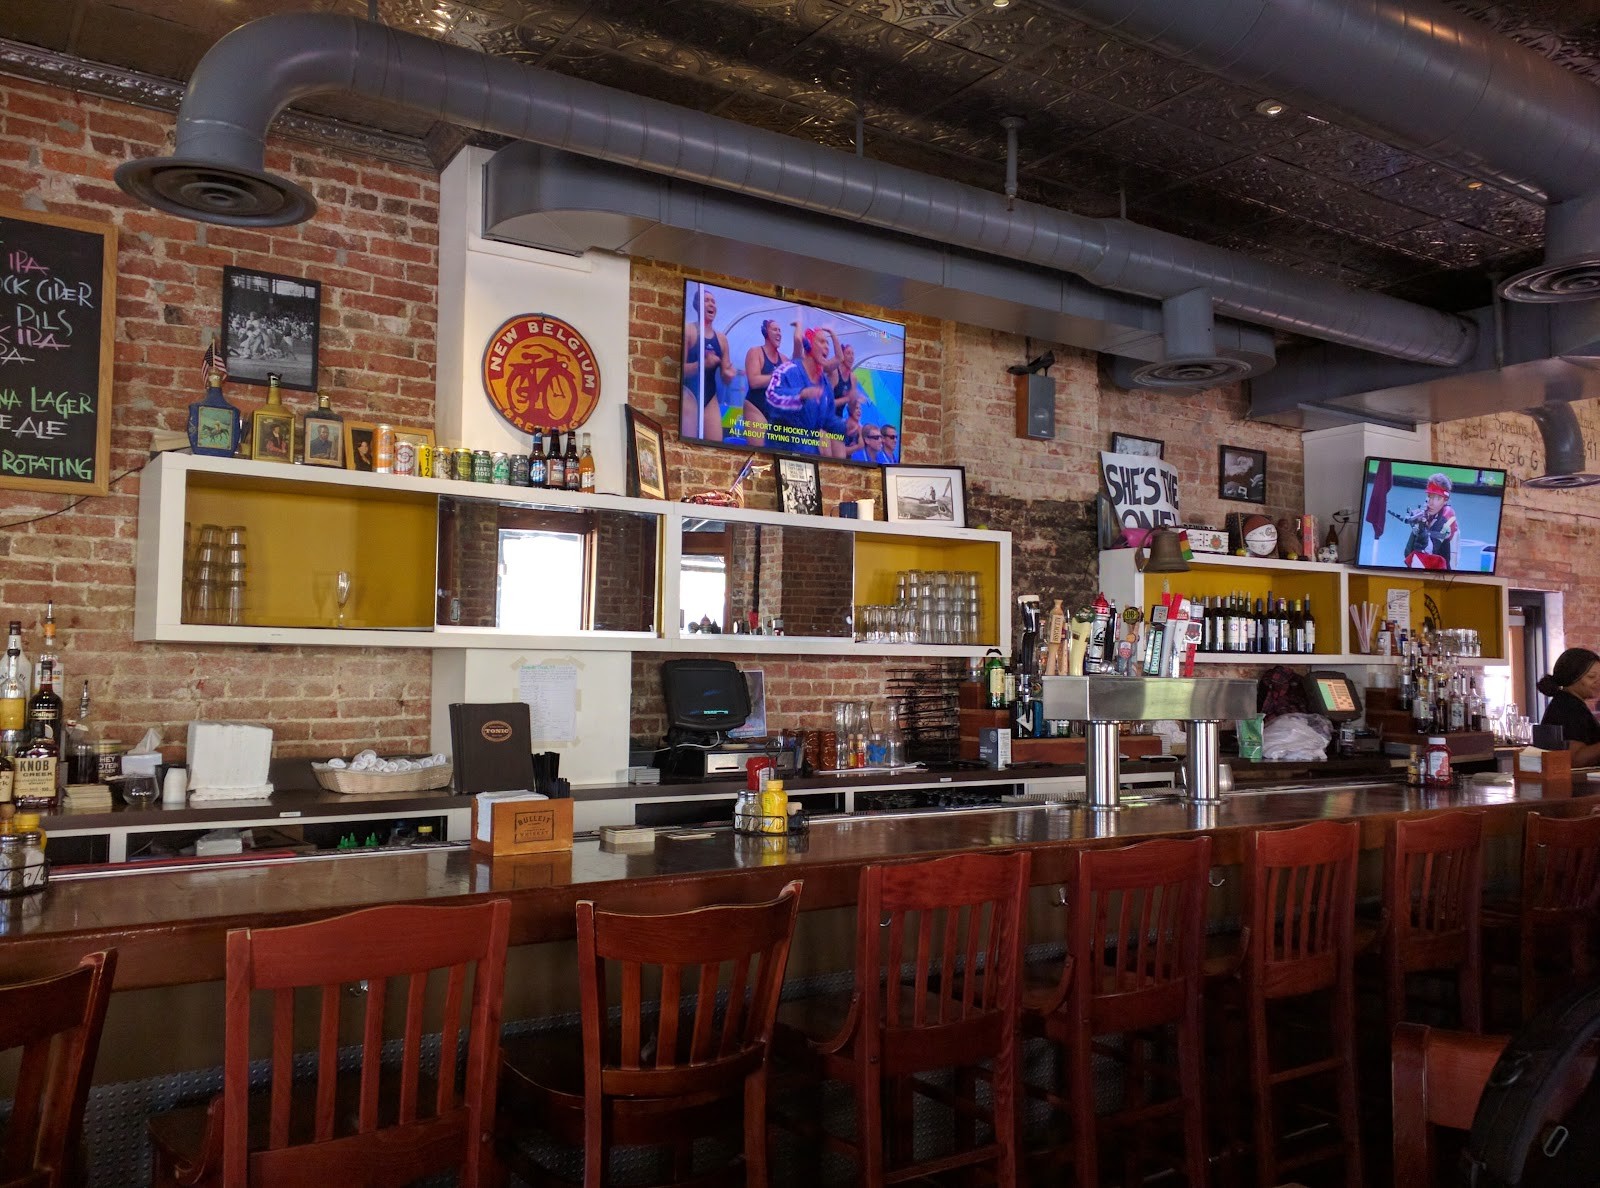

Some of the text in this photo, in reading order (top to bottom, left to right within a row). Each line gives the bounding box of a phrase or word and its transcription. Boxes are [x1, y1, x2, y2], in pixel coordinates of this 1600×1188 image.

[9, 249, 50, 275] IPA
[0, 274, 94, 309] CK CIDER
[16, 302, 73, 337] PILS
[18, 325, 71, 351] IPA
[490, 321, 595, 389] NEW BELGIUM
[30, 386, 95, 420] LAGER
[11, 416, 68, 440] ALE
[729, 427, 741, 436] ALL
[742, 429, 765, 439] ABOUT
[766, 433, 789, 442] TRYING
[801, 438, 820, 446] WORK
[739, 419, 750, 427] THE
[752, 421, 772, 430] SPORT
[773, 424, 782, 432] OF
[783, 426, 809, 437] HOCKEY,
[811, 429, 823, 438] YOU
[824, 432, 845, 441] KNOW
[2, 448, 92, 481] ROTATING
[1105, 464, 1179, 510] SHE'S THE
[20, 760, 49, 771] KNOB
[518, 815, 551, 826] BULLEIT
